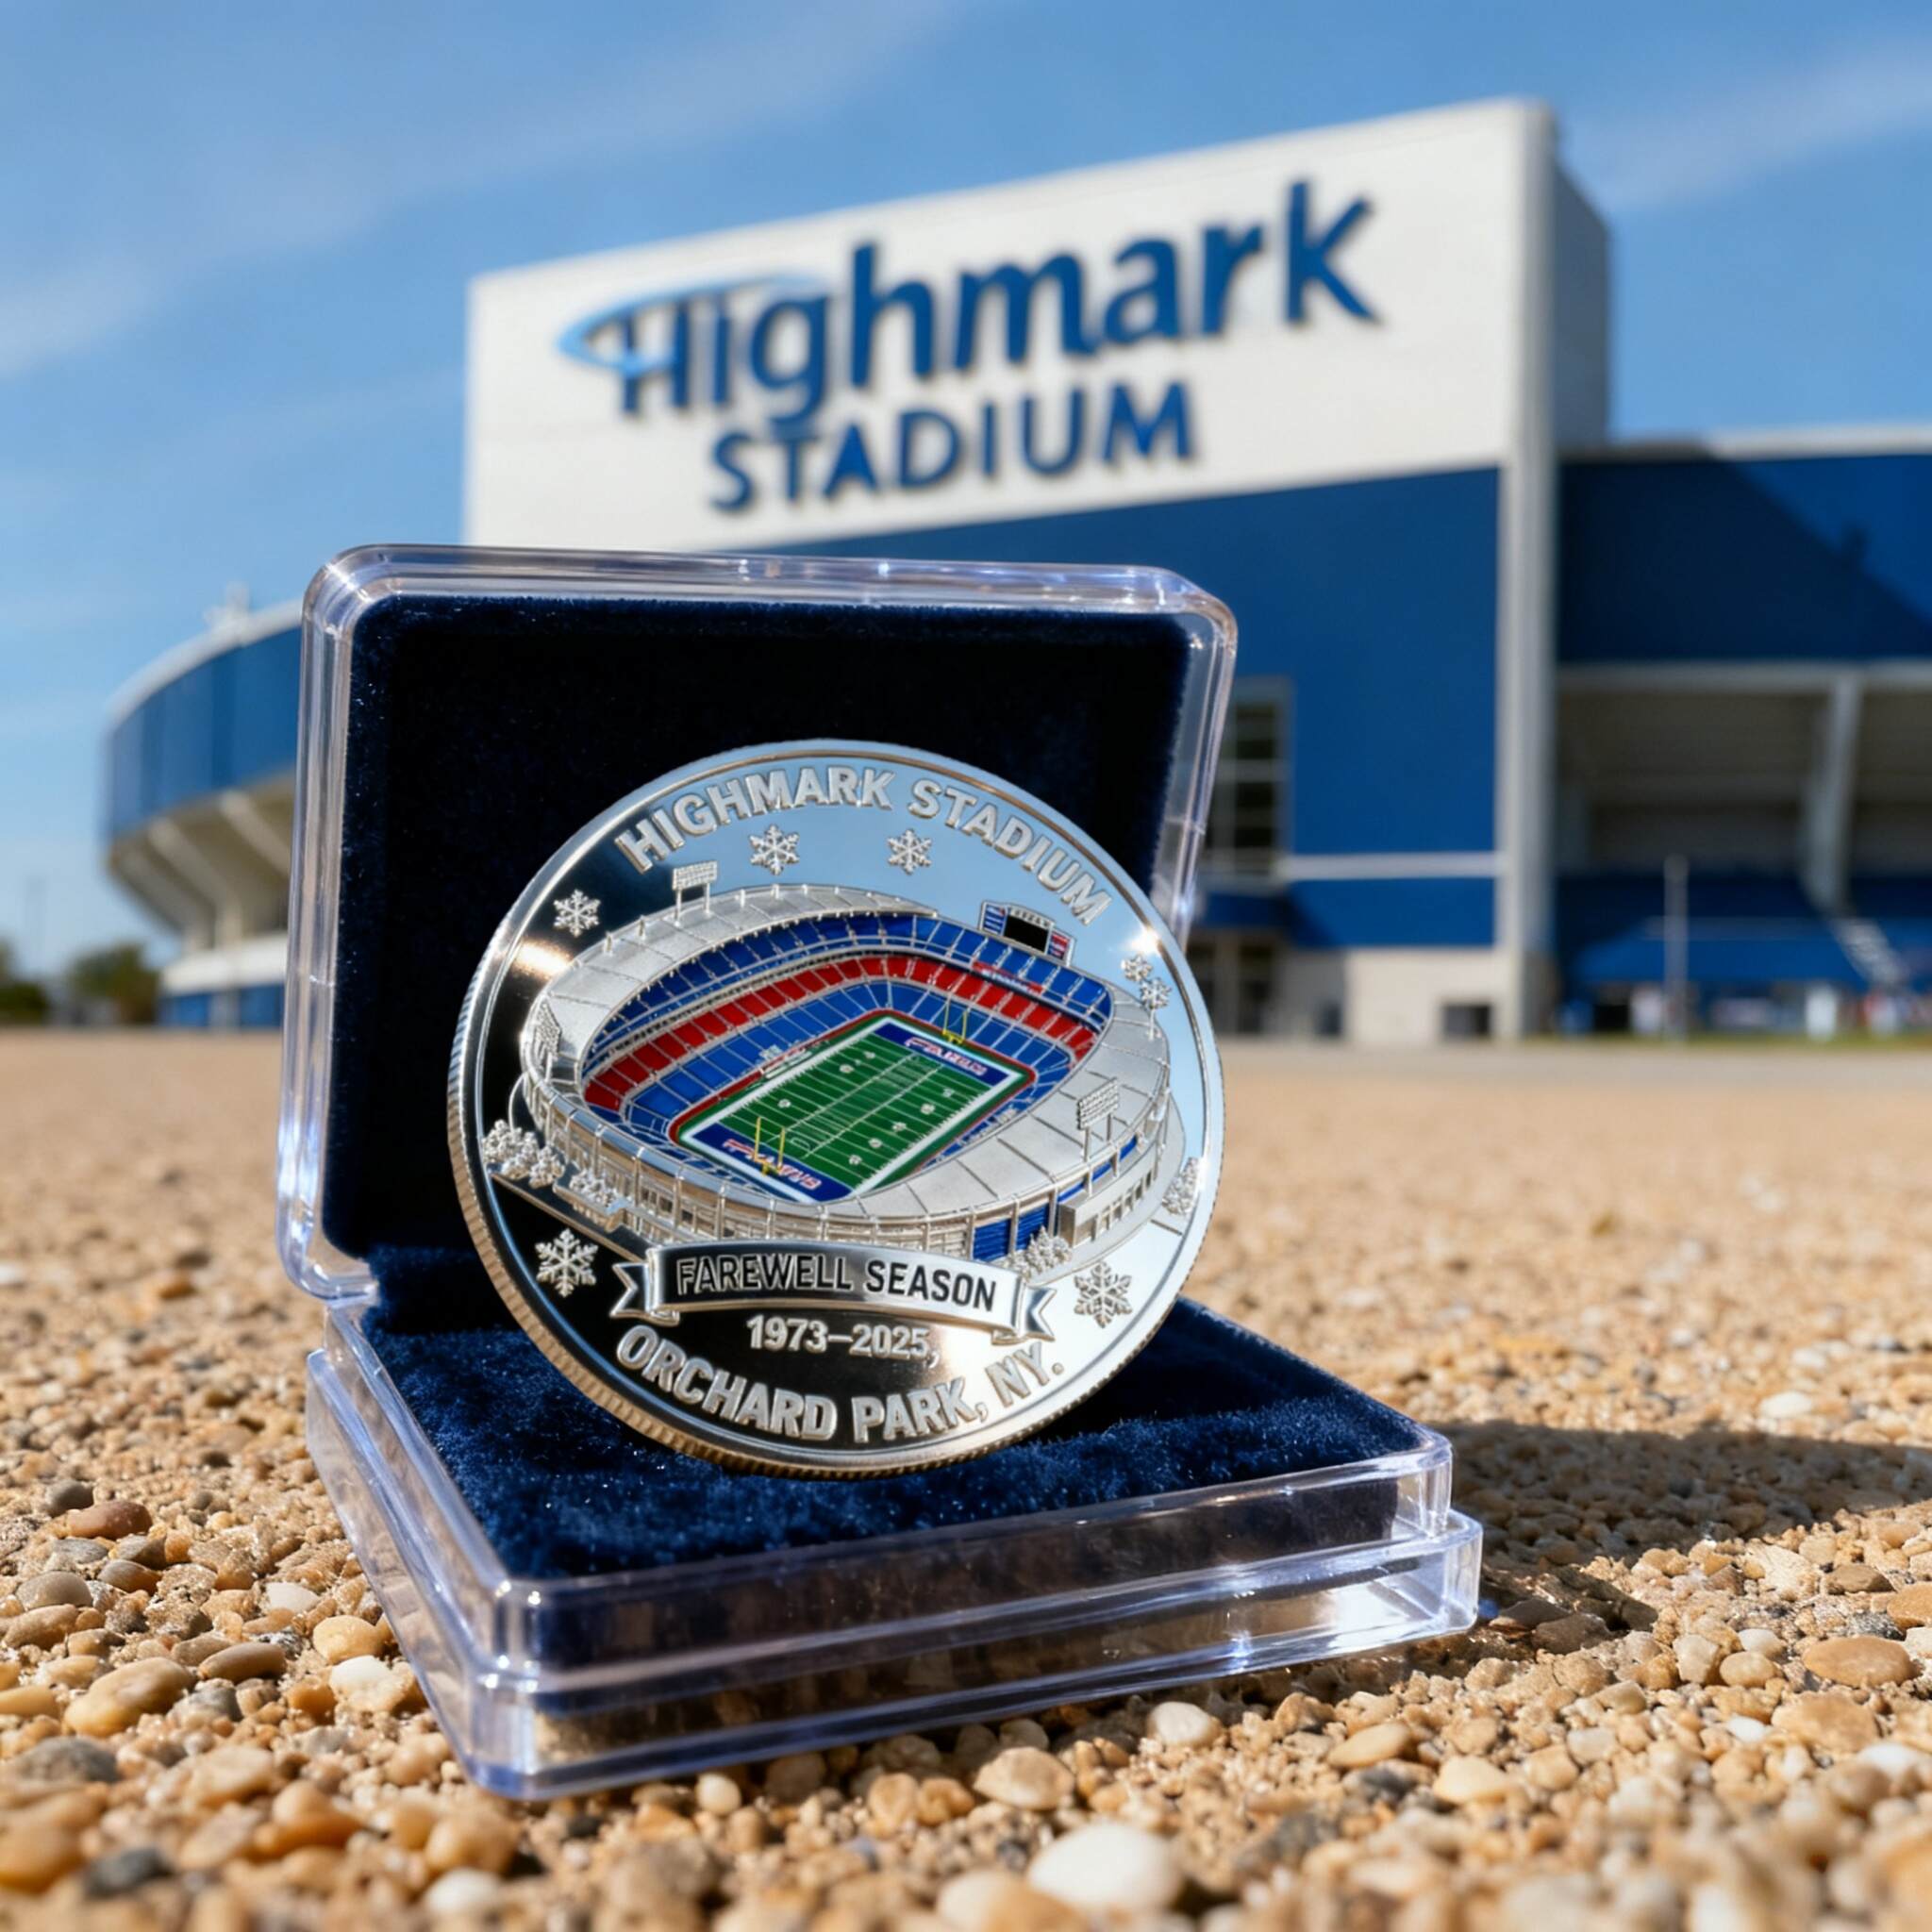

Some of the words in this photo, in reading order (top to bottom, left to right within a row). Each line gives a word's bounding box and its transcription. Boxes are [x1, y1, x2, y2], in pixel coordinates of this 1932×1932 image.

[615, 179, 1379, 430] Highmark
[709, 379, 1196, 513] STADIUM
[614, 766, 894, 874] HIGHMARK
[907, 777, 1113, 925] STADIUM
[676, 1252, 853, 1295] FAREWELL
[865, 1259, 997, 1312] SEASON
[616, 1324, 839, 1441] ORCHARD
[852, 1376, 990, 1444] PARK,
[985, 1341, 1065, 1407] NY.
